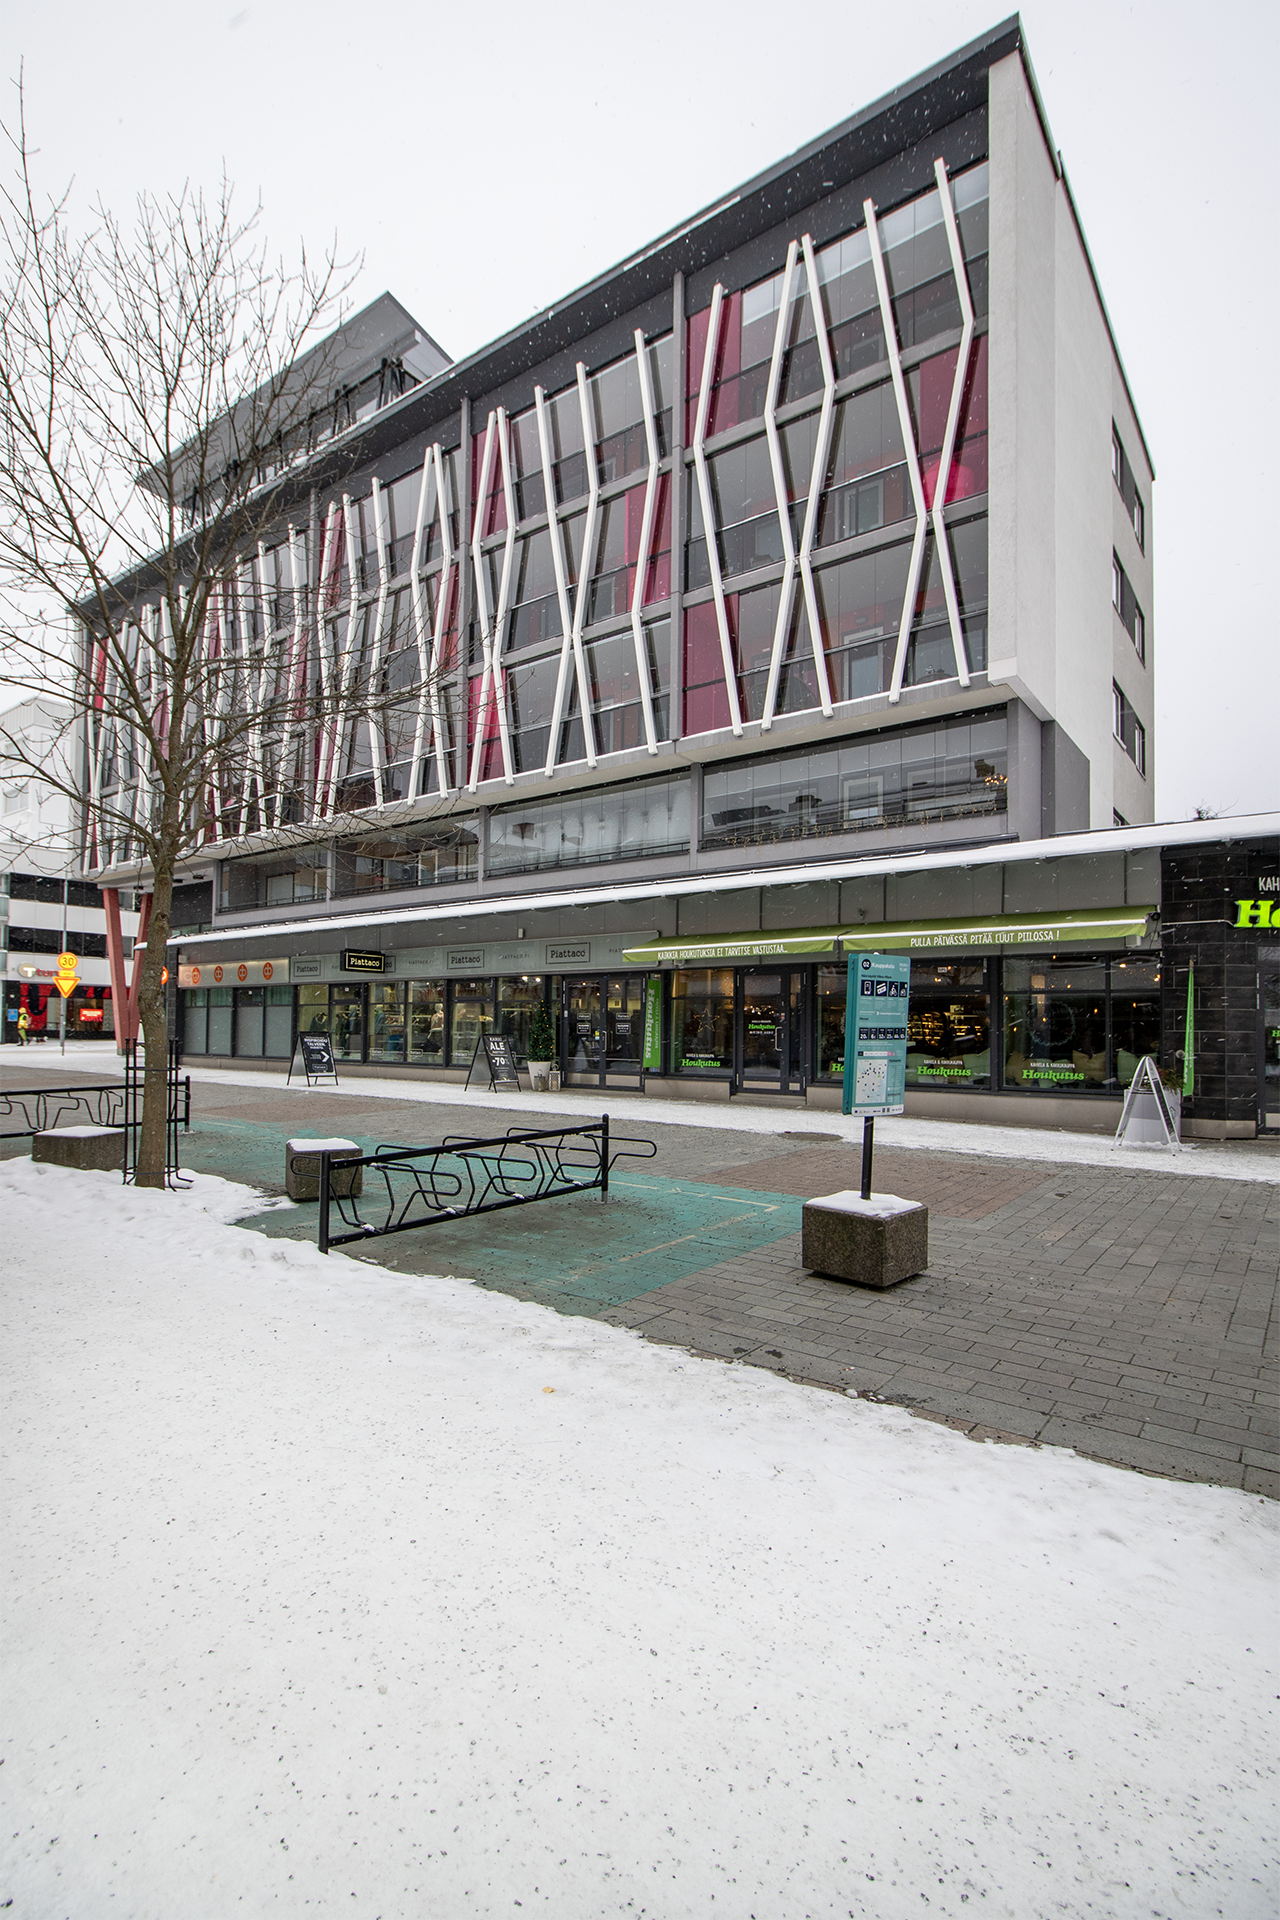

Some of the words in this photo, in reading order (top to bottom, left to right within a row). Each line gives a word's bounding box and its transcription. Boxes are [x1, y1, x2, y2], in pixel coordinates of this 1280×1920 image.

[911, 937, 931, 947] PULLA
[934, 934, 968, 946] PÄIVÄSSÄ
[970, 932, 993, 944] PITÄÄ
[996, 932, 1015, 943] LUUT
[1018, 930, 1054, 942] PIILOSSA
[657, 951, 679, 960] KAIKKIA
[680, 949, 716, 959] HOUKUTUKSIA
[717, 948, 723, 957] EI
[725, 946, 751, 956] TARVITSE
[62, 957, 75, 966] 30
[646, 988, 655, 1059] Houkutus
[490, 1041, 506, 1051] ALE
[681, 1058, 721, 1069] Houkutus
[916, 1065, 972, 1078] Houkutus
[1021, 1069, 1085, 1082] Houkutus
